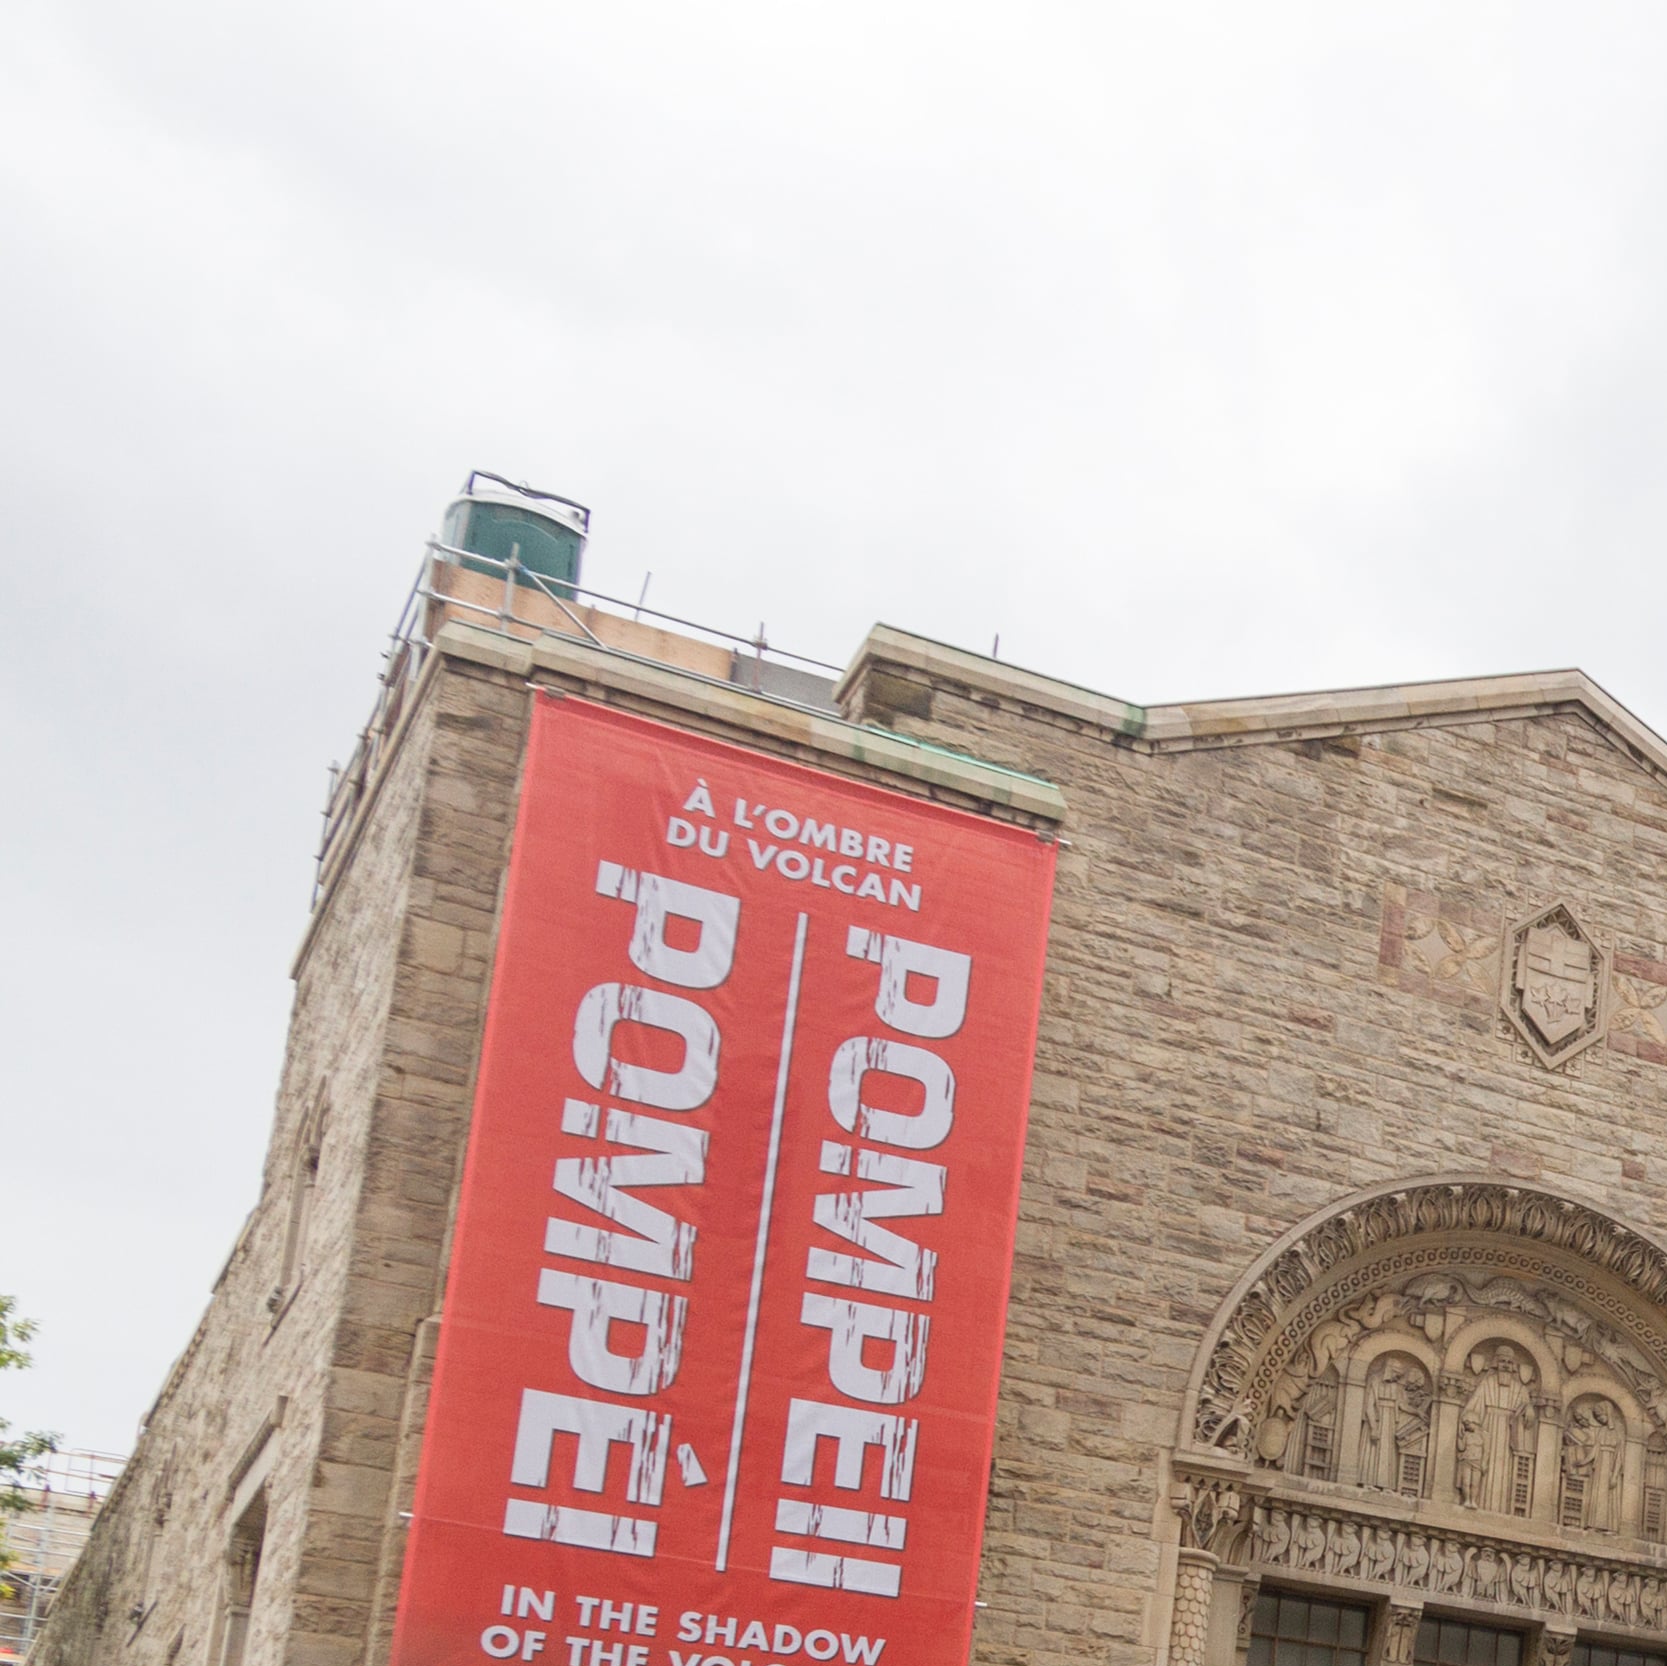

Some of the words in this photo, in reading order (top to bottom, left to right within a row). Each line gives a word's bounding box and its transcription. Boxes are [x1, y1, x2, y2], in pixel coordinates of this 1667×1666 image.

[666, 816, 729, 857] DU
[747, 838, 922, 912] VOLCAN
[683, 778, 715, 818] À
[734, 798, 914, 873] L'OMBRE
[503, 860, 740, 1557] POMPÉI
[769, 925, 971, 1598] POMPEII
[480, 1625, 547, 1661] OF
[500, 1584, 555, 1621] IN
[575, 1595, 659, 1636] THE
[677, 1611, 886, 1666] SHADOW
